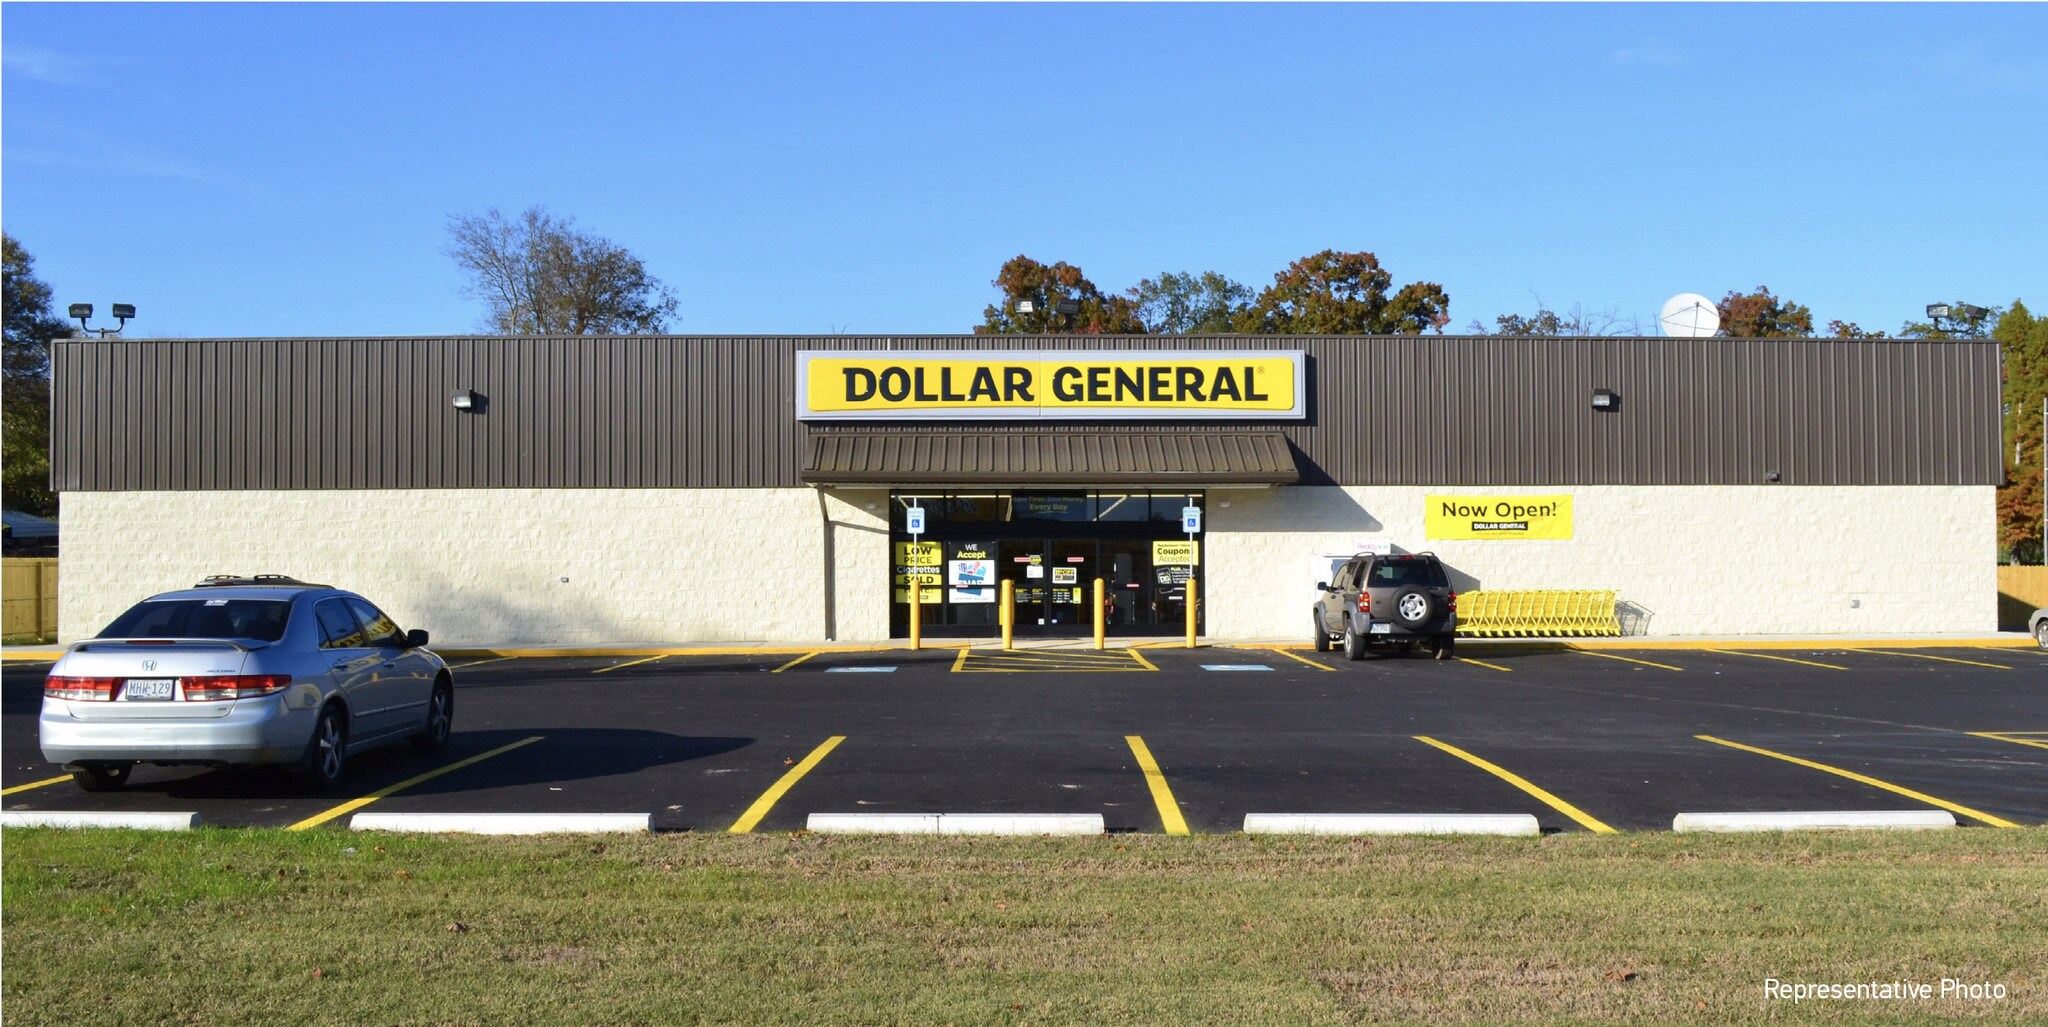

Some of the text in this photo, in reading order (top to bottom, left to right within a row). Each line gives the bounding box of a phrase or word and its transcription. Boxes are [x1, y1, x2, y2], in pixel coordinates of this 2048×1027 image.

[842, 366, 1035, 402] DOLLAR
[1442, 502, 1557, 520] Now Open!
[903, 546, 932, 556] LOW
[957, 551, 986, 560] Accept
[896, 565, 940, 574] Cigarettes
[152, 682, 171, 694] 129
